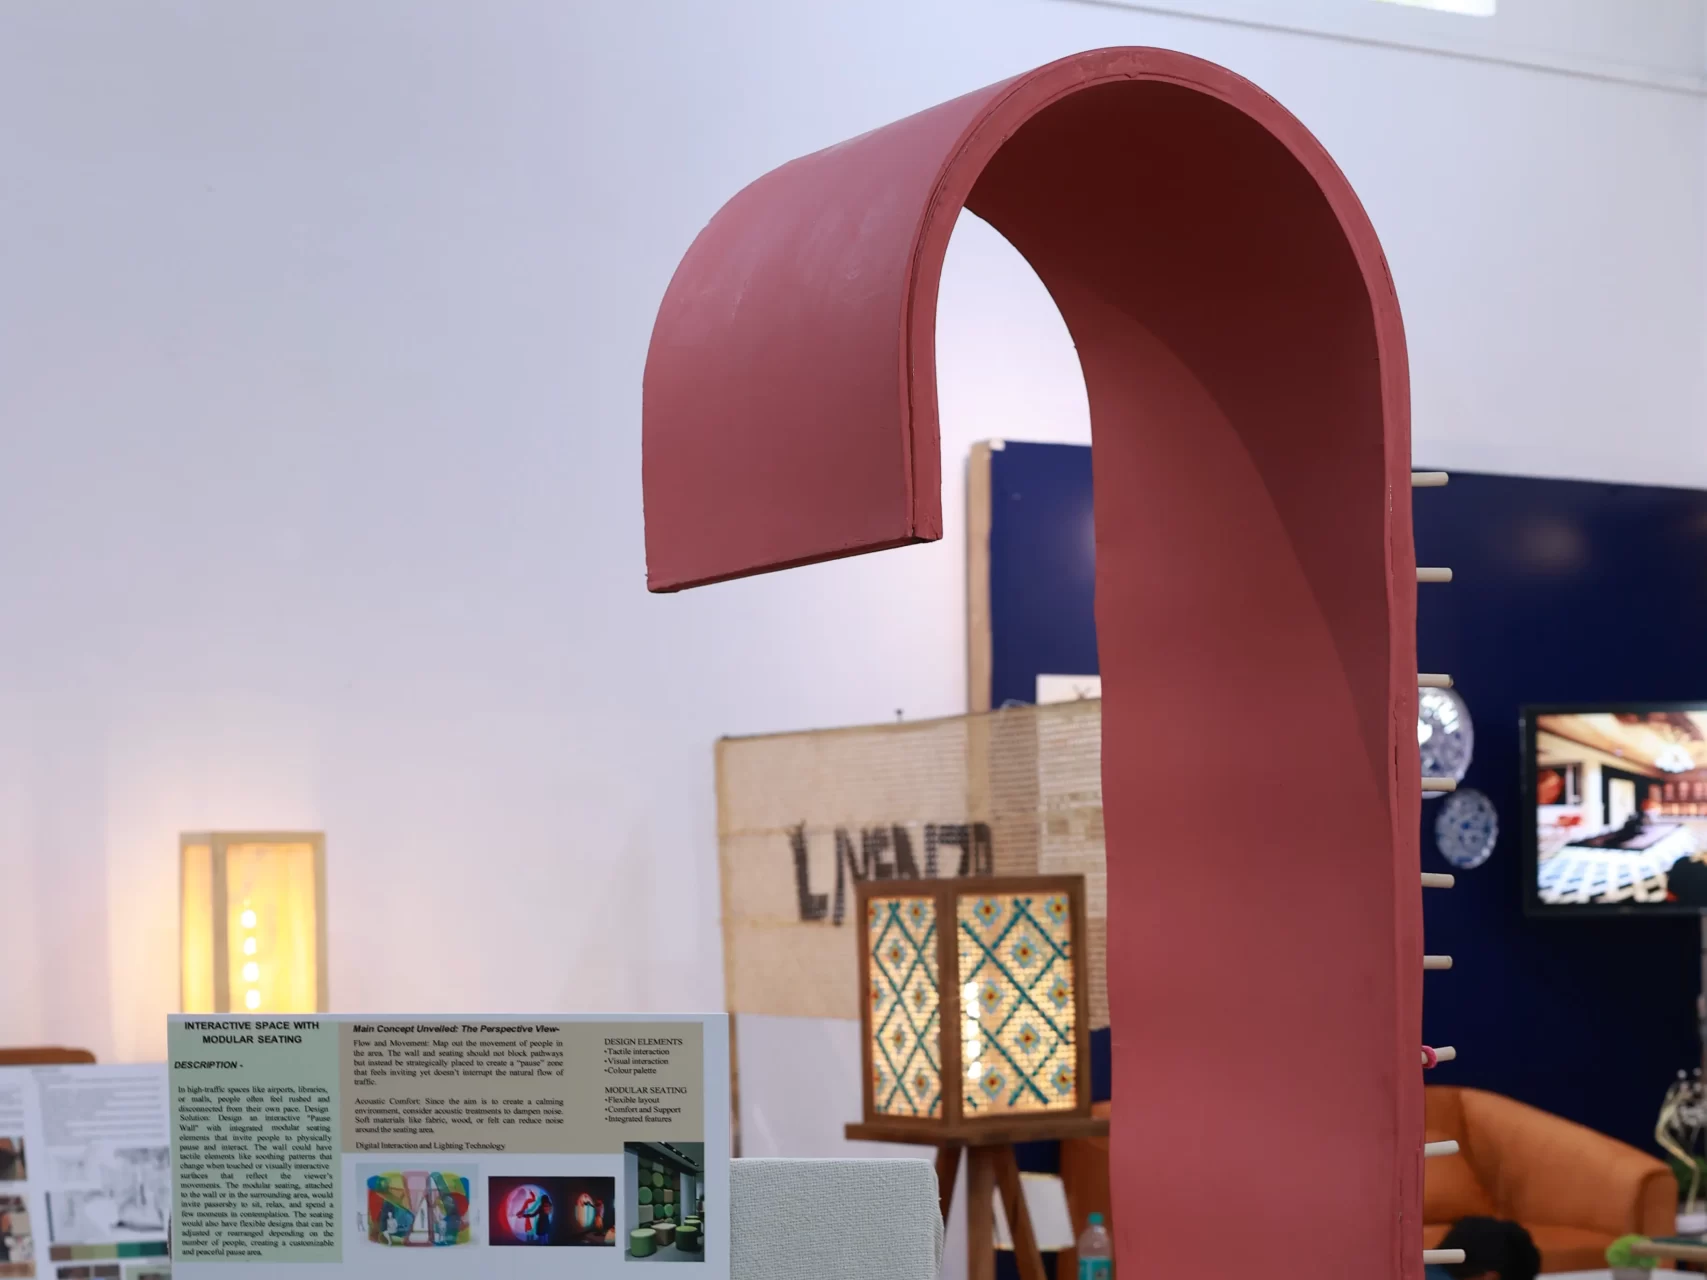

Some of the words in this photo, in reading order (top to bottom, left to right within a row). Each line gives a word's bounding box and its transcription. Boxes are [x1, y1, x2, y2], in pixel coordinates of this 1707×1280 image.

[184, 1021, 251, 1030] INTERACTIVE
[255, 1021, 289, 1029] SPACE
[293, 1021, 319, 1029] WITH
[376, 1024, 415, 1034] Concept
[416, 1024, 459, 1032] Unveiled:
[461, 1024, 478, 1032] The
[479, 1024, 533, 1034] Perspective
[202, 1035, 253, 1043] MODULAR
[257, 1035, 302, 1043] SEATING
[432, 1039, 448, 1048] Map
[529, 1039, 553, 1048] people
[438, 1050, 464, 1058] seating
[530, 1049, 563, 1058] pathways
[173, 1060, 239, 1069] DESCRIPTION
[406, 1059, 448, 1067] strategically
[450, 1059, 474, 1067] placed
[389, 1068, 417, 1077] inviting
[419, 1069, 431, 1077] yet
[462, 1068, 492, 1077] interrupt
[495, 1068, 506, 1076] the
[536, 1068, 552, 1076] flow
[633, 1066, 656, 1075] palette
[637, 1096, 660, 1104] layout
[653, 1106, 681, 1114] Support
[355, 1141, 380, 1150] Digital
[418, 1141, 432, 1149] and
[433, 1142, 464, 1150] Lighting
[464, 1142, 505, 1150] Technology
